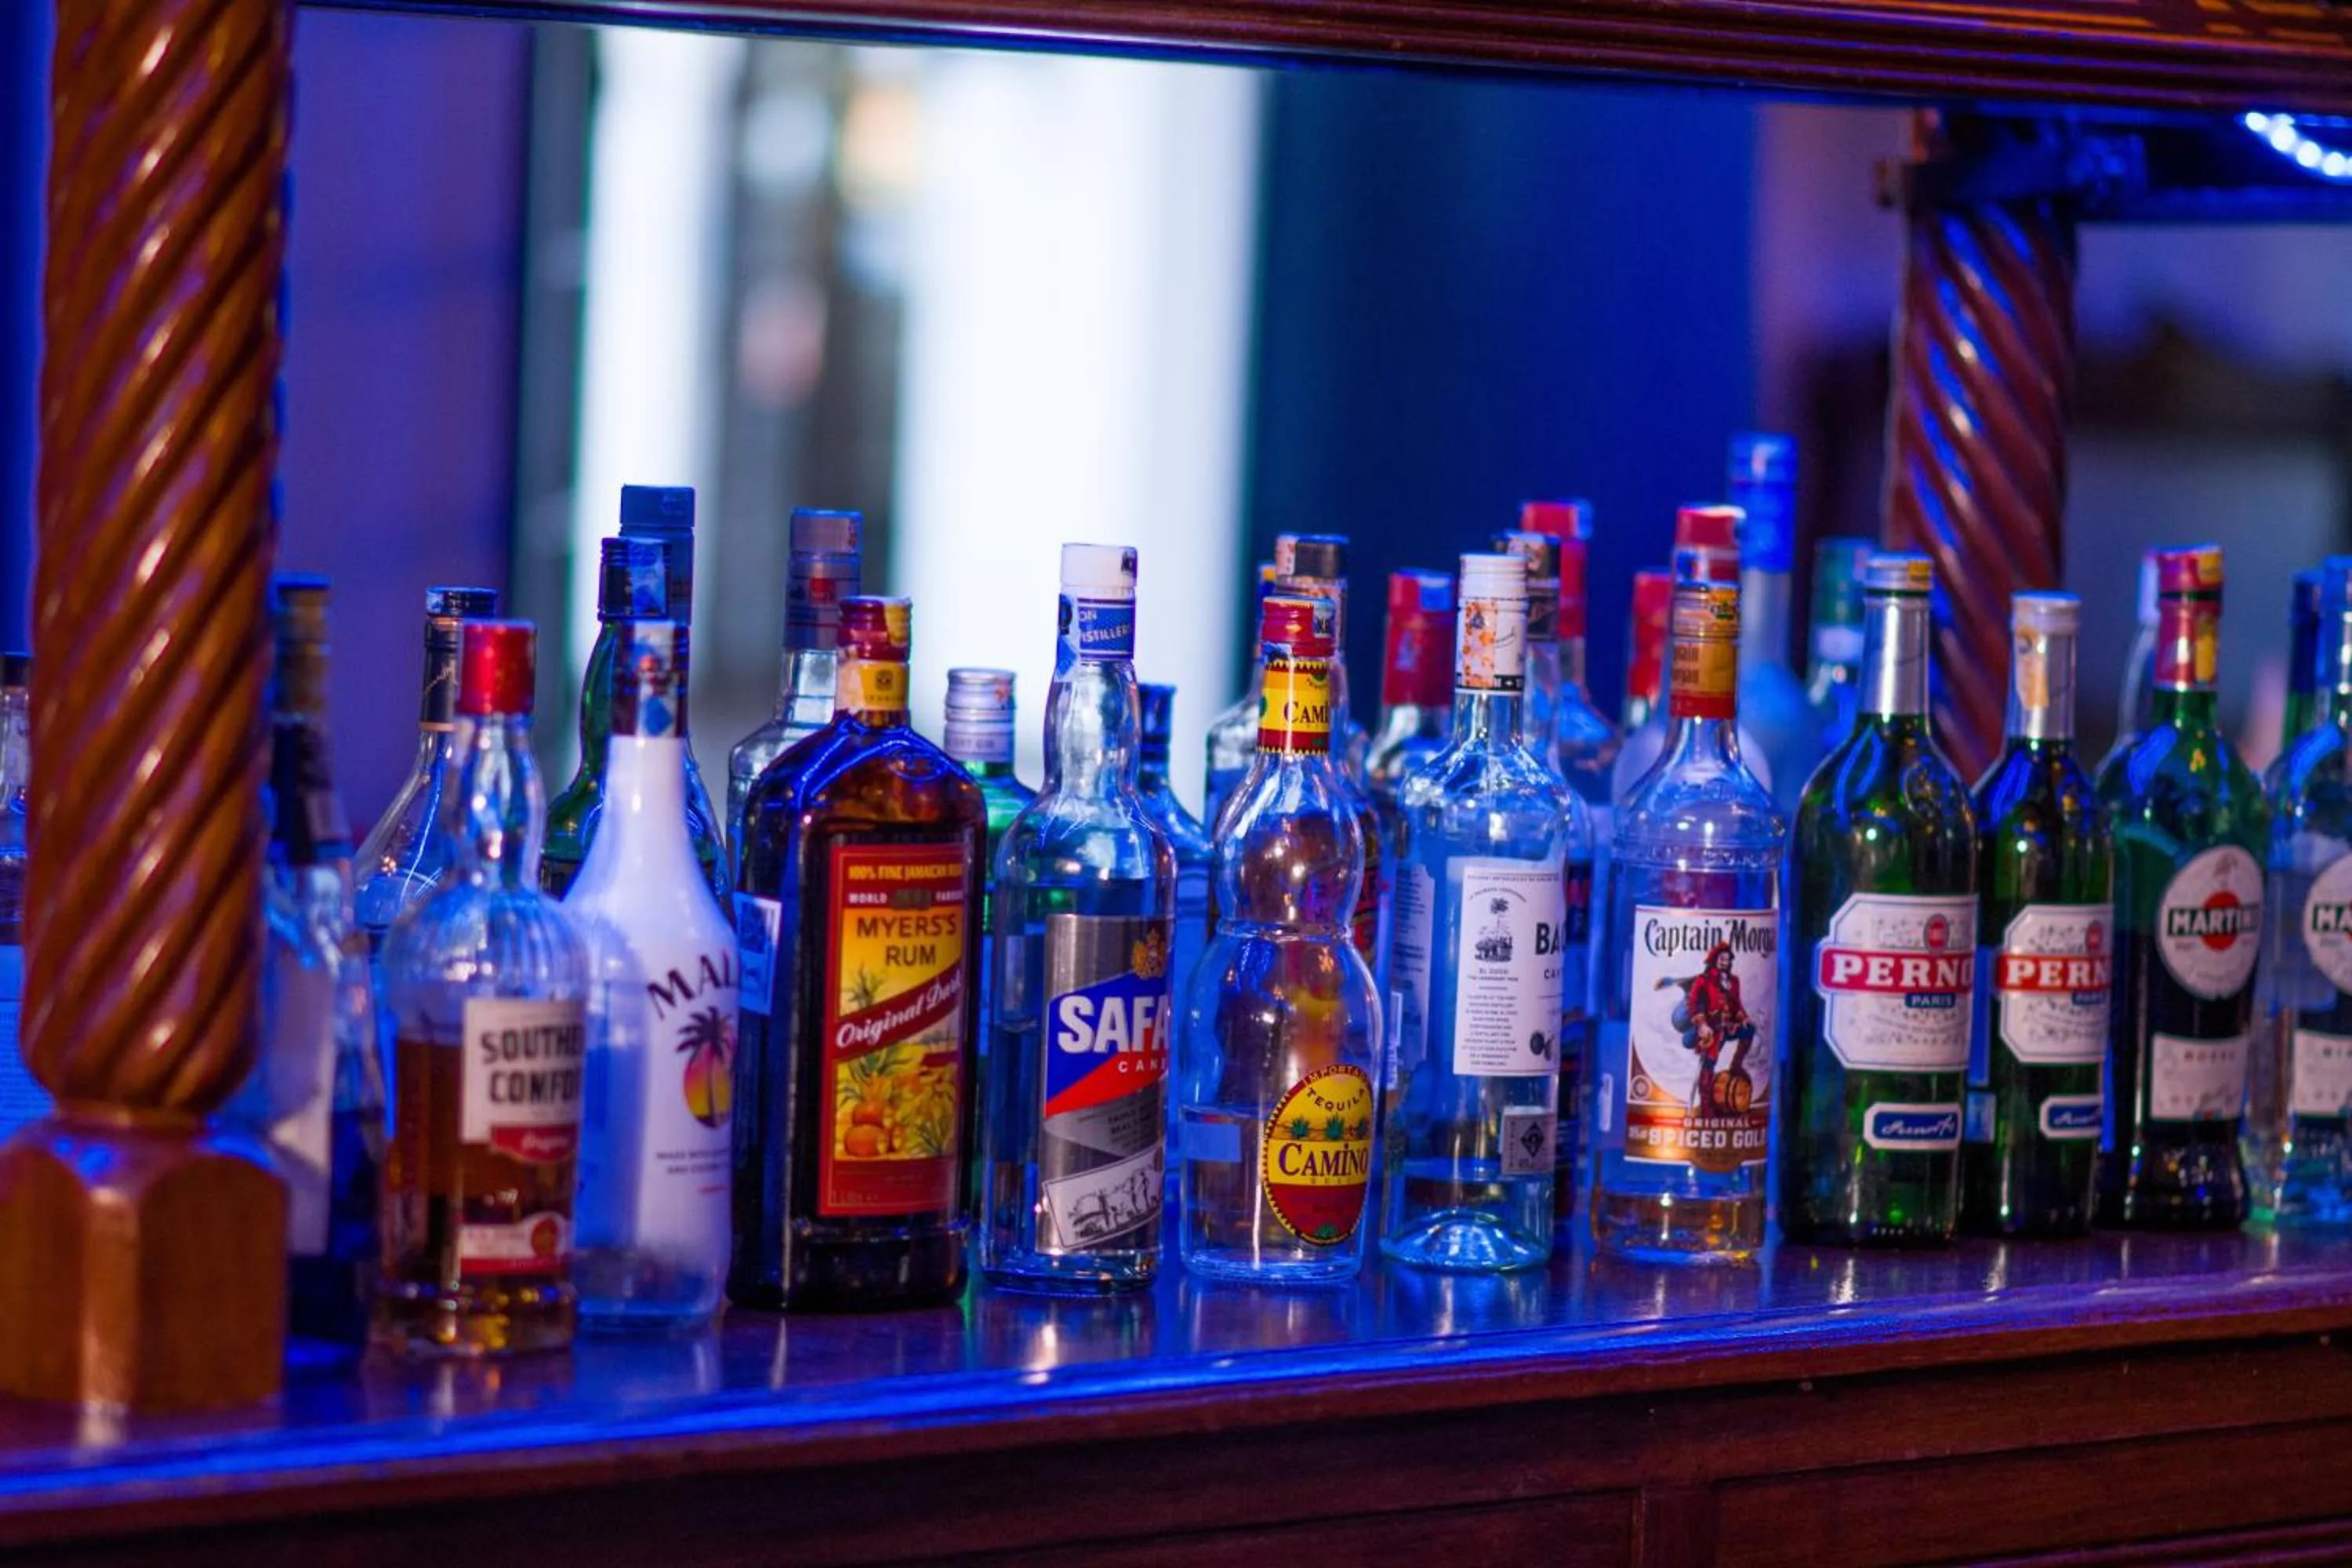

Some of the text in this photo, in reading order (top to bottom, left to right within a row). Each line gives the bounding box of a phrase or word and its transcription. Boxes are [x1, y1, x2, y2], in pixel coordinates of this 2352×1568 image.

[884, 944, 937, 966] RUM
[1645, 917, 1723, 958] Captain
[835, 994, 924, 1049] Original
[1649, 1126, 1726, 1149] SPICED
[1279, 1142, 1370, 1177] CAMINO
